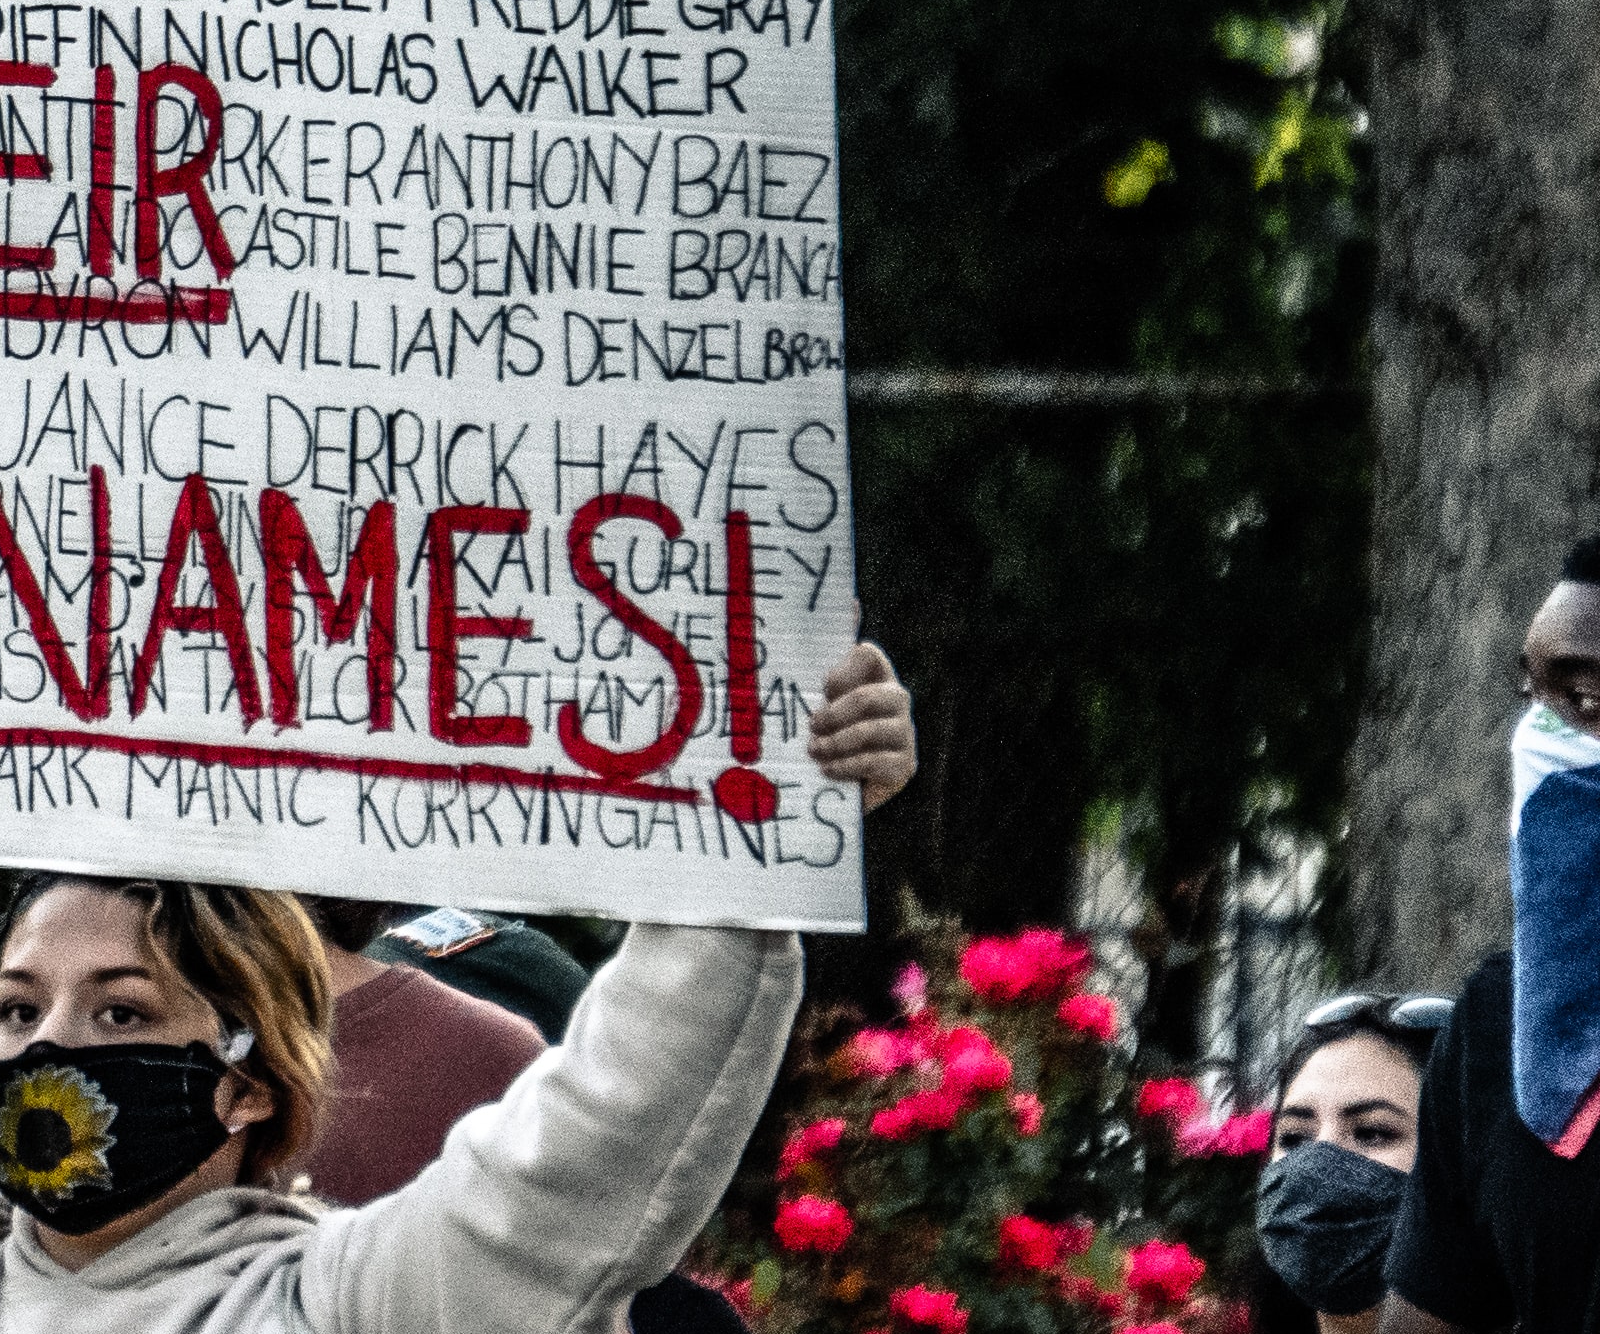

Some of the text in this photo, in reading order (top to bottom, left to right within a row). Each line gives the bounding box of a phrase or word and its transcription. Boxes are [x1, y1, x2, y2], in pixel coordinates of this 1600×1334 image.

[165, 8, 438, 104] NICHOLAS
[457, 37, 750, 118] WALKER
[146, 94, 383, 206] PARKER
[393, 124, 662, 215] ANTHONY
[671, 134, 831, 225] BAEZ
[213, 202, 416, 280] CASTILE
[432, 212, 646, 298] BENNIE
[2, 258, 214, 366] BYRON
[229, 286, 546, 381] WILLIAMS
[565, 311, 768, 386] DENZEL
[265, 393, 531, 511] DERRICK
[554, 420, 841, 534] HAYES
[407, 510, 552, 598] AKAI
[575, 530, 832, 612] GURLEY
[126, 742, 328, 827] MANIC
[356, 758, 586, 853] KORRYN
[595, 770, 848, 870] GAINES
